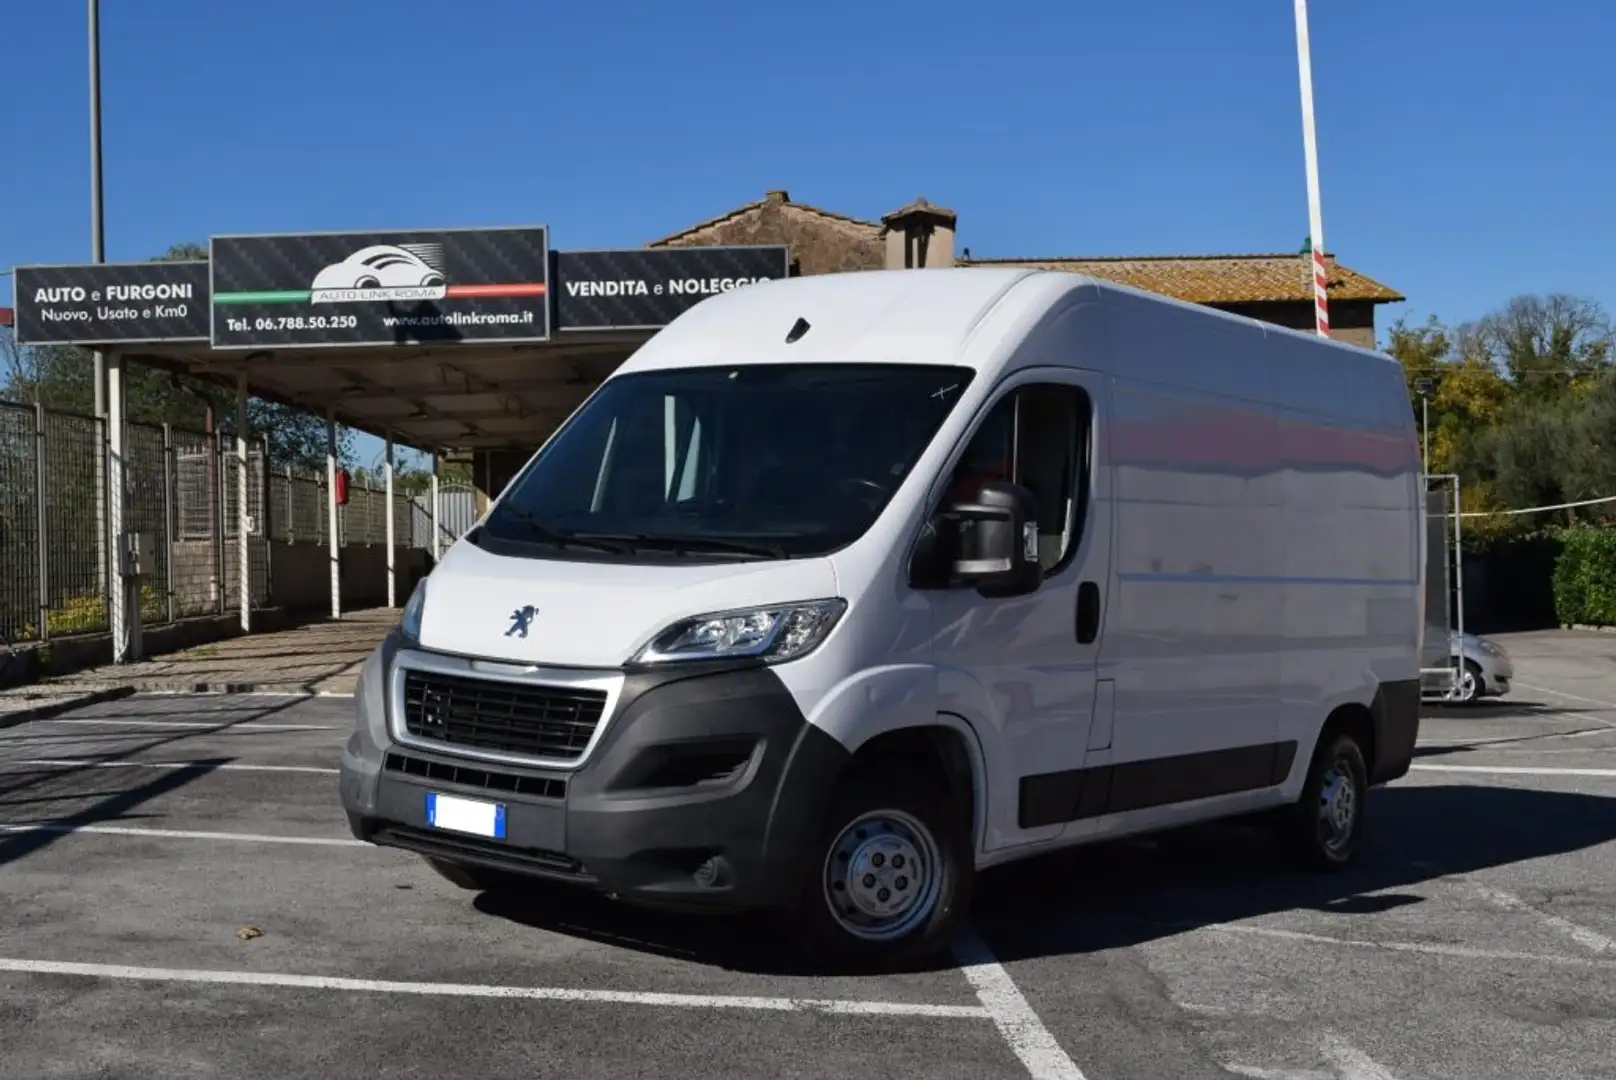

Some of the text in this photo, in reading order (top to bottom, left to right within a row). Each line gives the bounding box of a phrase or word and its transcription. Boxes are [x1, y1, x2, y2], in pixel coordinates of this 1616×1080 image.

[34, 284, 192, 303] AUTO e FURGONI
[319, 288, 437, 300] AUTO LINK ROMA
[566, 281, 648, 296] VENDITA
[653, 284, 663, 295] e
[41, 304, 188, 322] Nuovo, Usato e Km0
[383, 311, 534, 327] www.autolinkroma.it
[227, 315, 357, 331] Tel. 06.788.50.250
